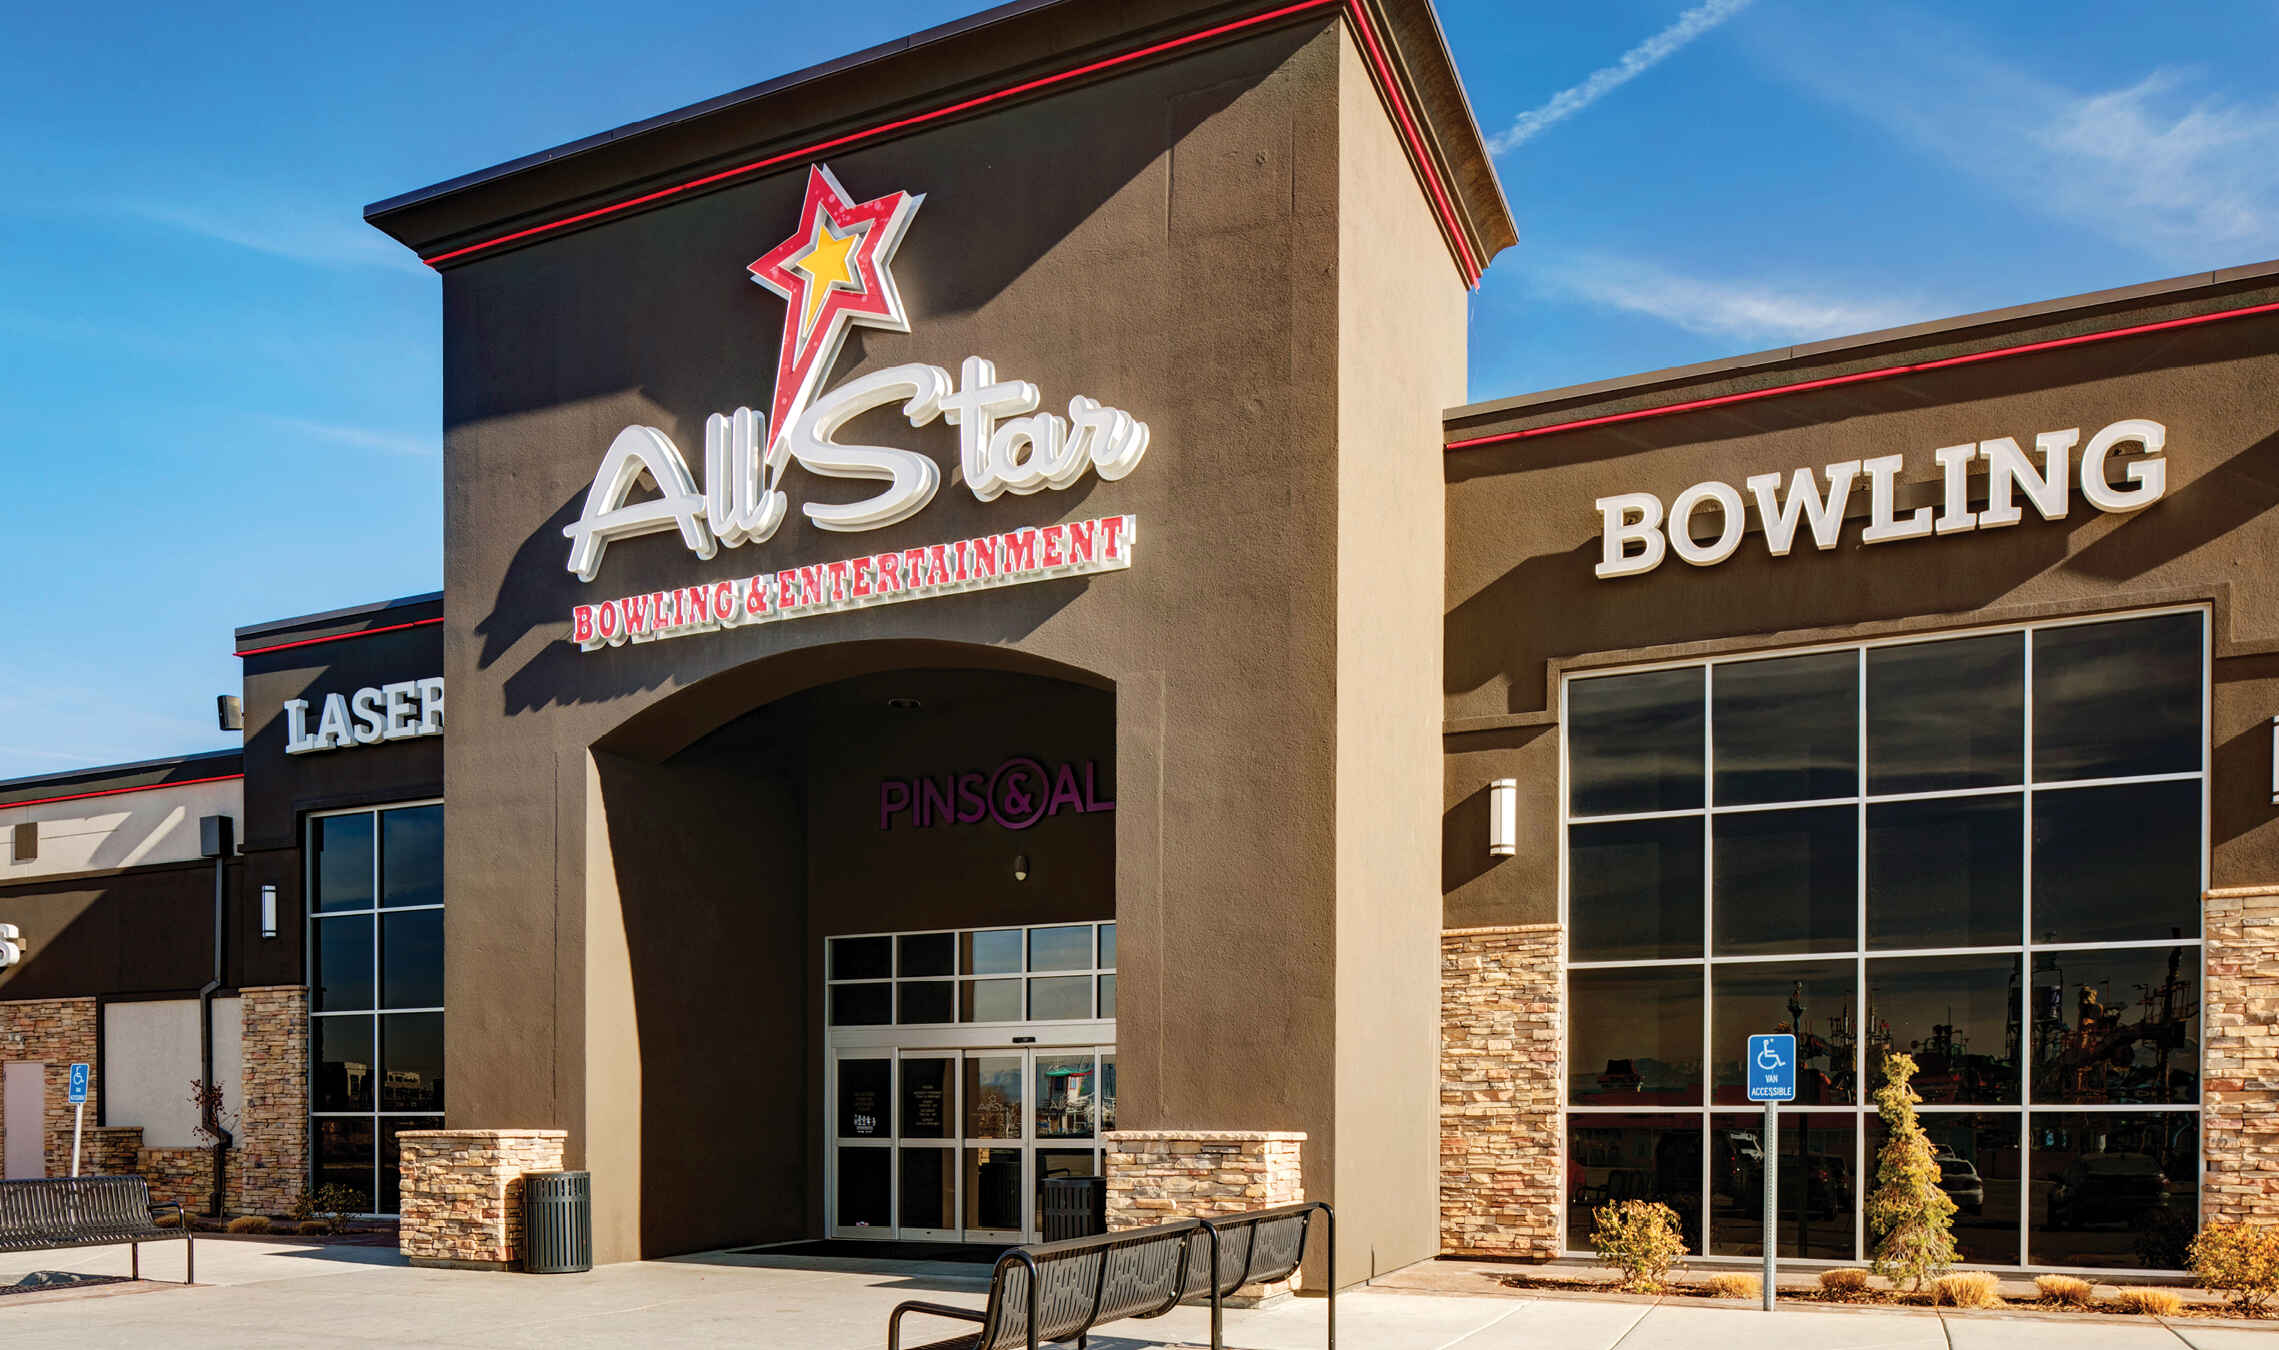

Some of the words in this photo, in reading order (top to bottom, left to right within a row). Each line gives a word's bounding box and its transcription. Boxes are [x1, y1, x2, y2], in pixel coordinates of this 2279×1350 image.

[1595, 418, 2167, 579] BOWLING
[572, 580, 737, 652] BOWLING
[746, 574, 775, 617] &
[776, 513, 1137, 612] ENTERTAINMENT
[879, 773, 987, 830] PINS
[1751, 1086, 1793, 1097] ACCESSIBLE
[1765, 1074, 1779, 1084] VAN
